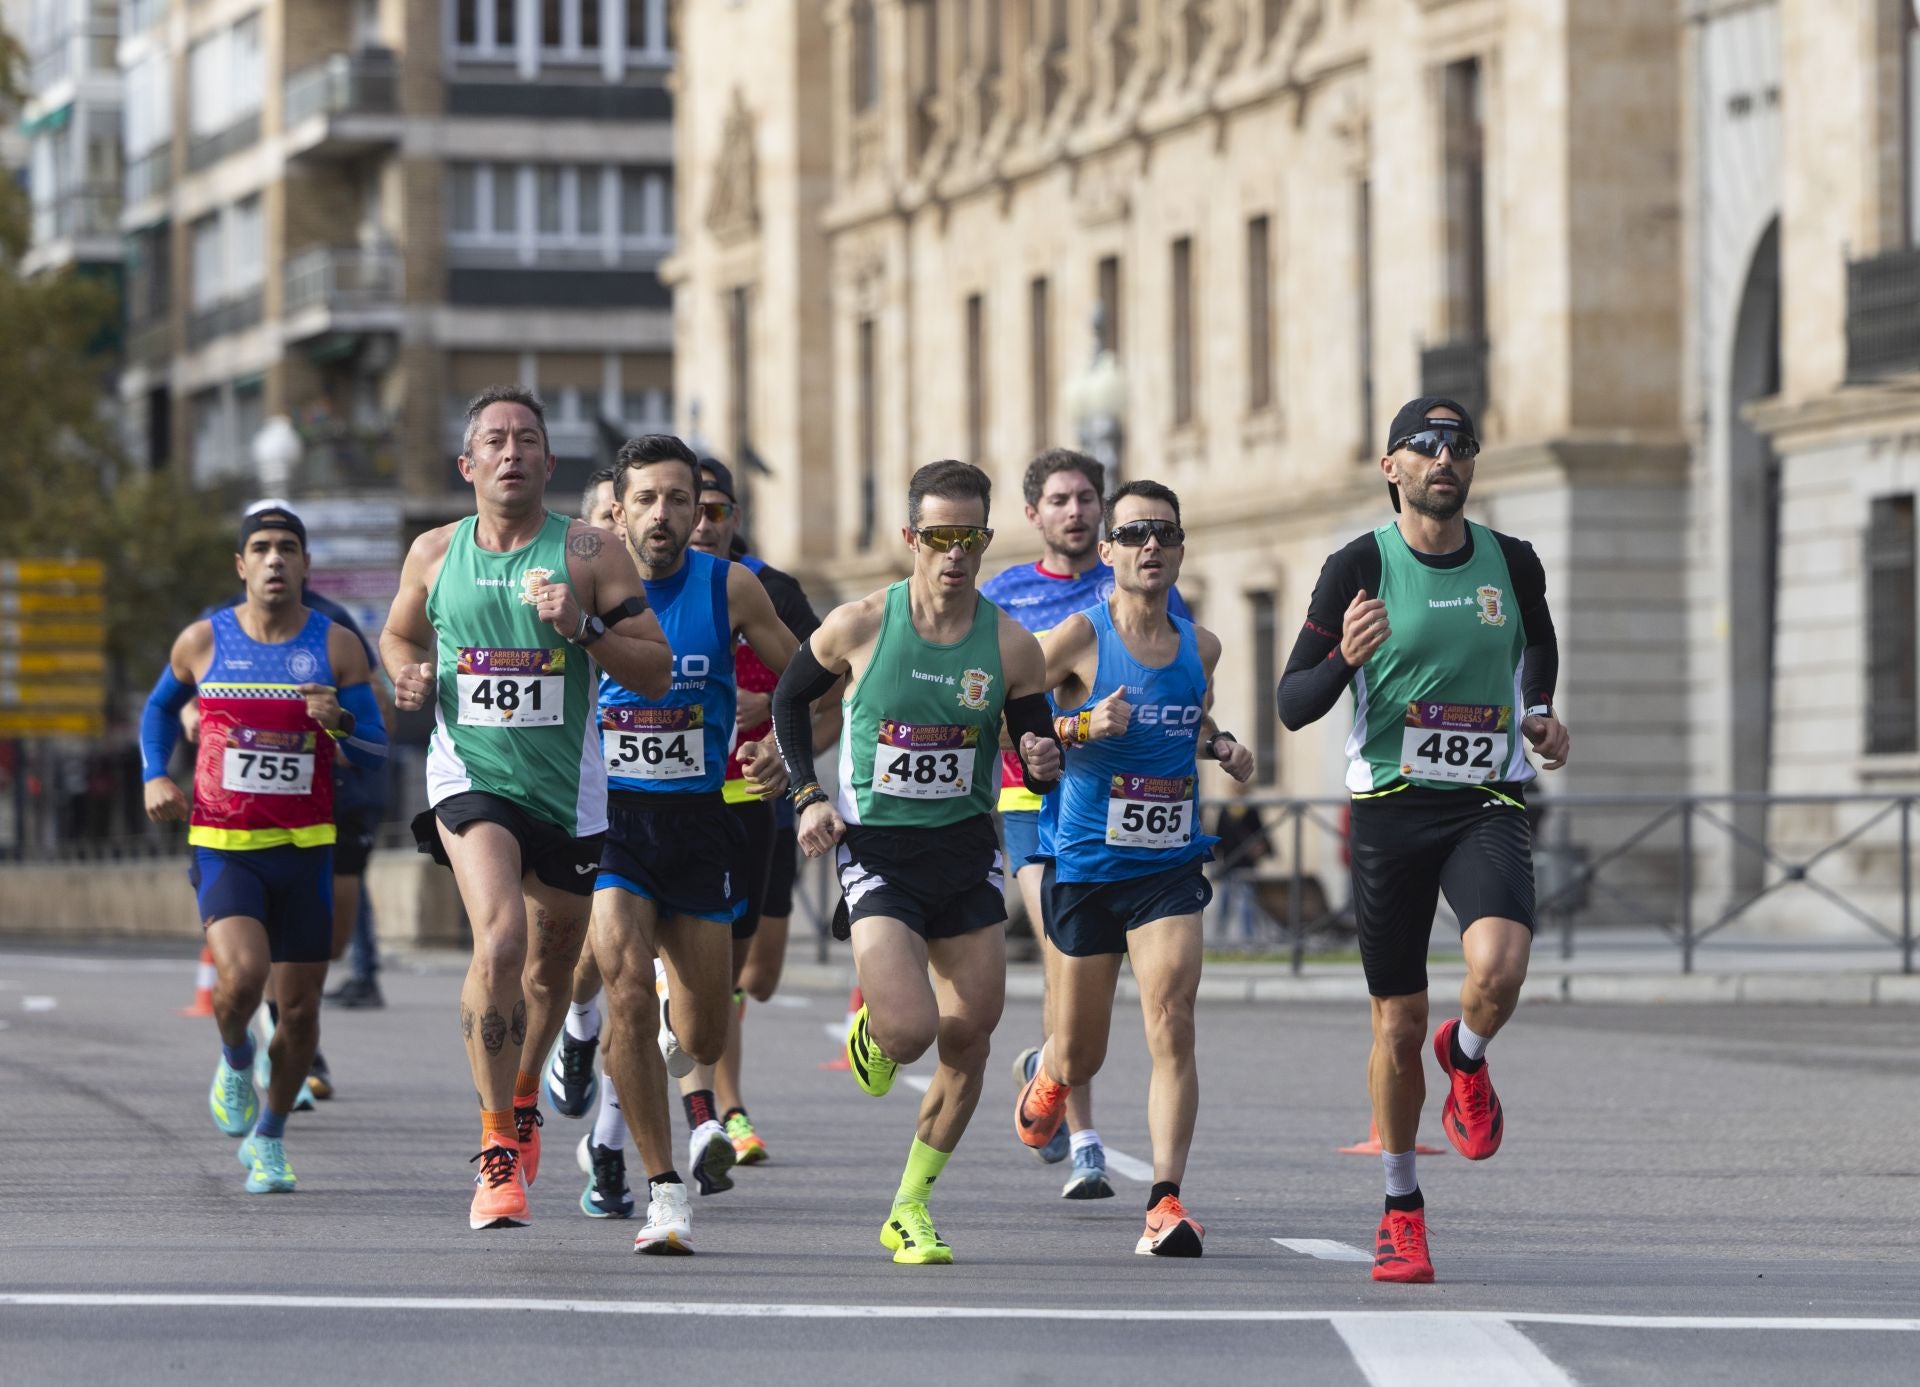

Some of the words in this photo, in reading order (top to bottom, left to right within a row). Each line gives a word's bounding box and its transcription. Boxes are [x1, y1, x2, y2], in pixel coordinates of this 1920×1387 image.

[1428, 597, 1462, 608] luanvi
[476, 650, 489, 665] 9ª
[490, 658, 530, 667] EMPRESAS
[911, 669, 944, 683] luanvi
[671, 680, 706, 690] nning
[471, 679, 542, 711] 481
[620, 710, 633, 723] 9ª
[1429, 705, 1443, 719] 9ª
[1444, 706, 1473, 714] CARRERA
[1443, 712, 1482, 723] EMPRESAS
[634, 716, 672, 724] EMPRESAS
[899, 725, 911, 739] 9ª
[911, 732, 948, 742] EMPRESAS
[619, 734, 688, 765] 564
[1417, 733, 1493, 768] 482
[238, 753, 300, 782] 755
[888, 753, 959, 784] 483
[1121, 803, 1183, 834] 565
